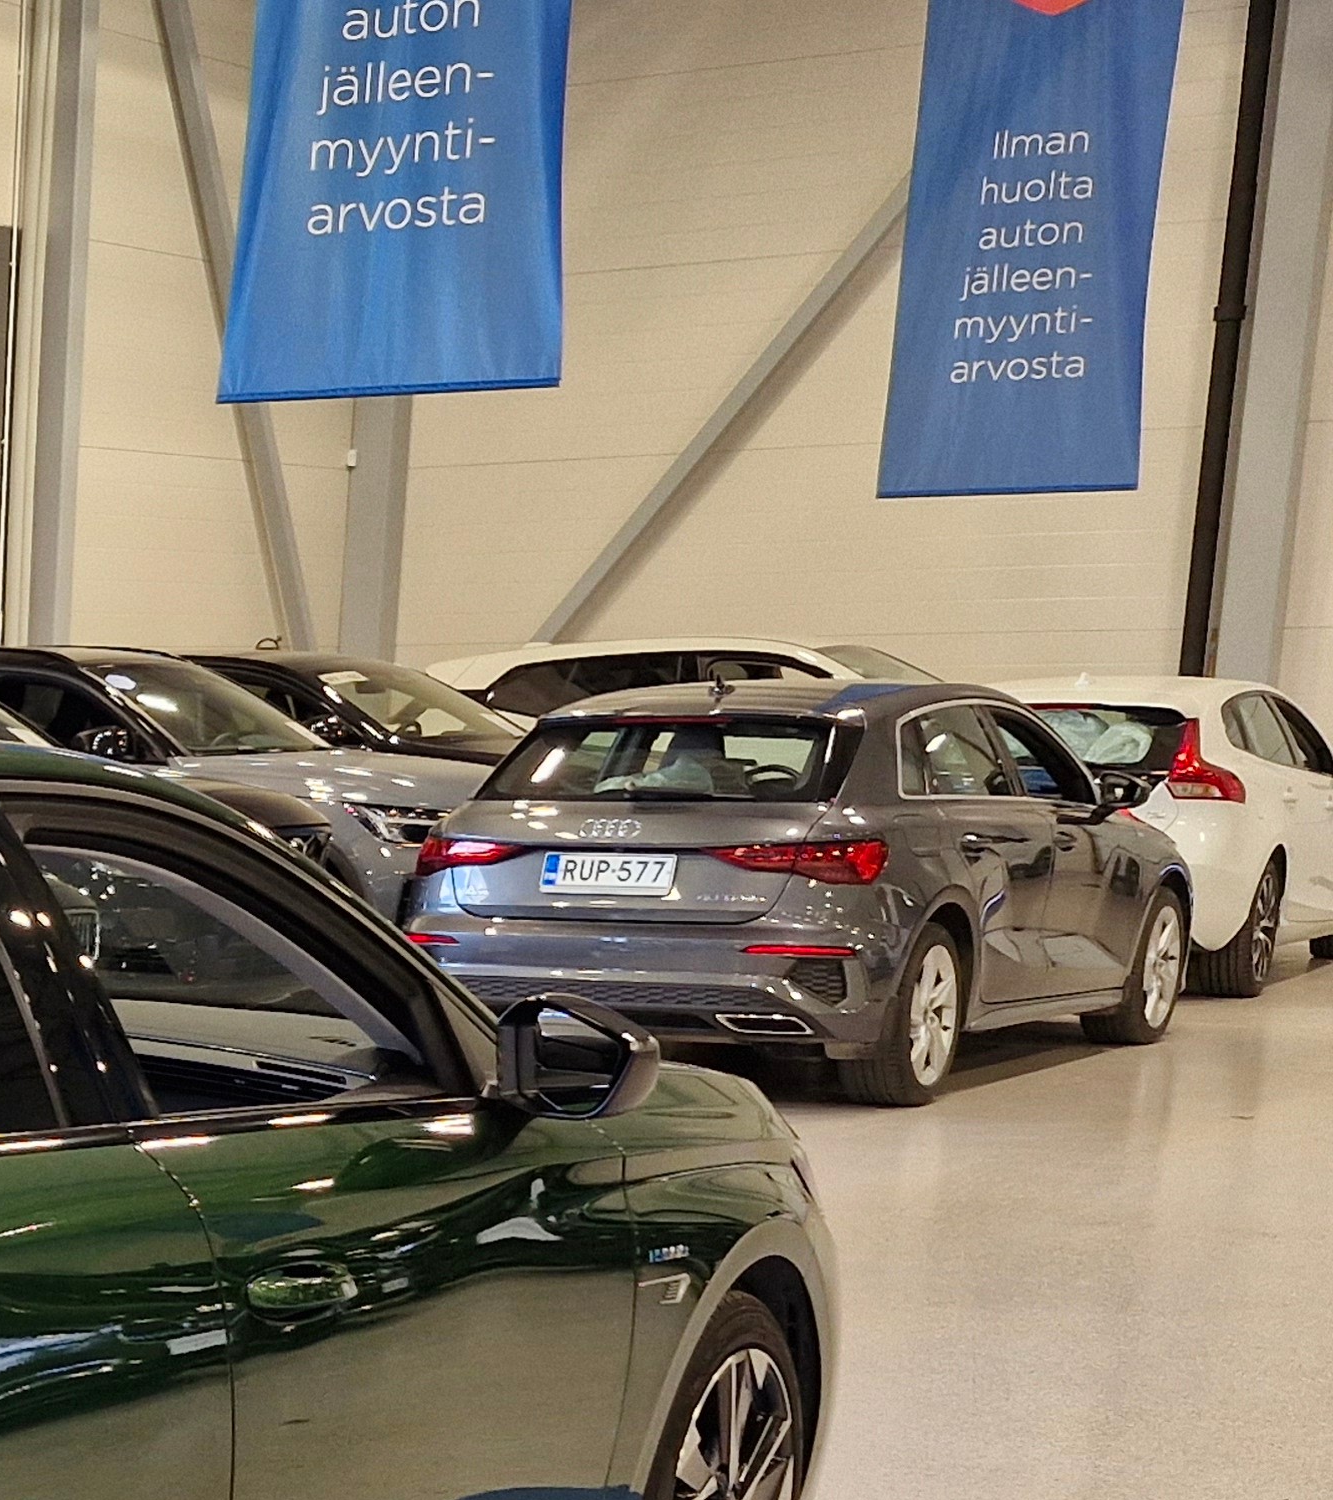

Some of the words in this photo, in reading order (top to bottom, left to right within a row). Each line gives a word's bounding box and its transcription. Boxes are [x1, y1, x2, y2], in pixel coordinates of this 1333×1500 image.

[341, 0, 480, 41] auton
[316, 60, 495, 116] jälleen-
[309, 117, 496, 178] myynti-
[992, 129, 1090, 160] Ilman
[980, 169, 1094, 206] huolta
[306, 186, 486, 236] arvosta
[978, 218, 1084, 251] auton
[959, 263, 1093, 302] jälleen-
[953, 304, 1094, 344] myynti-
[949, 351, 1085, 384] arvosta
[562, 859, 667, 884] RUP-577
